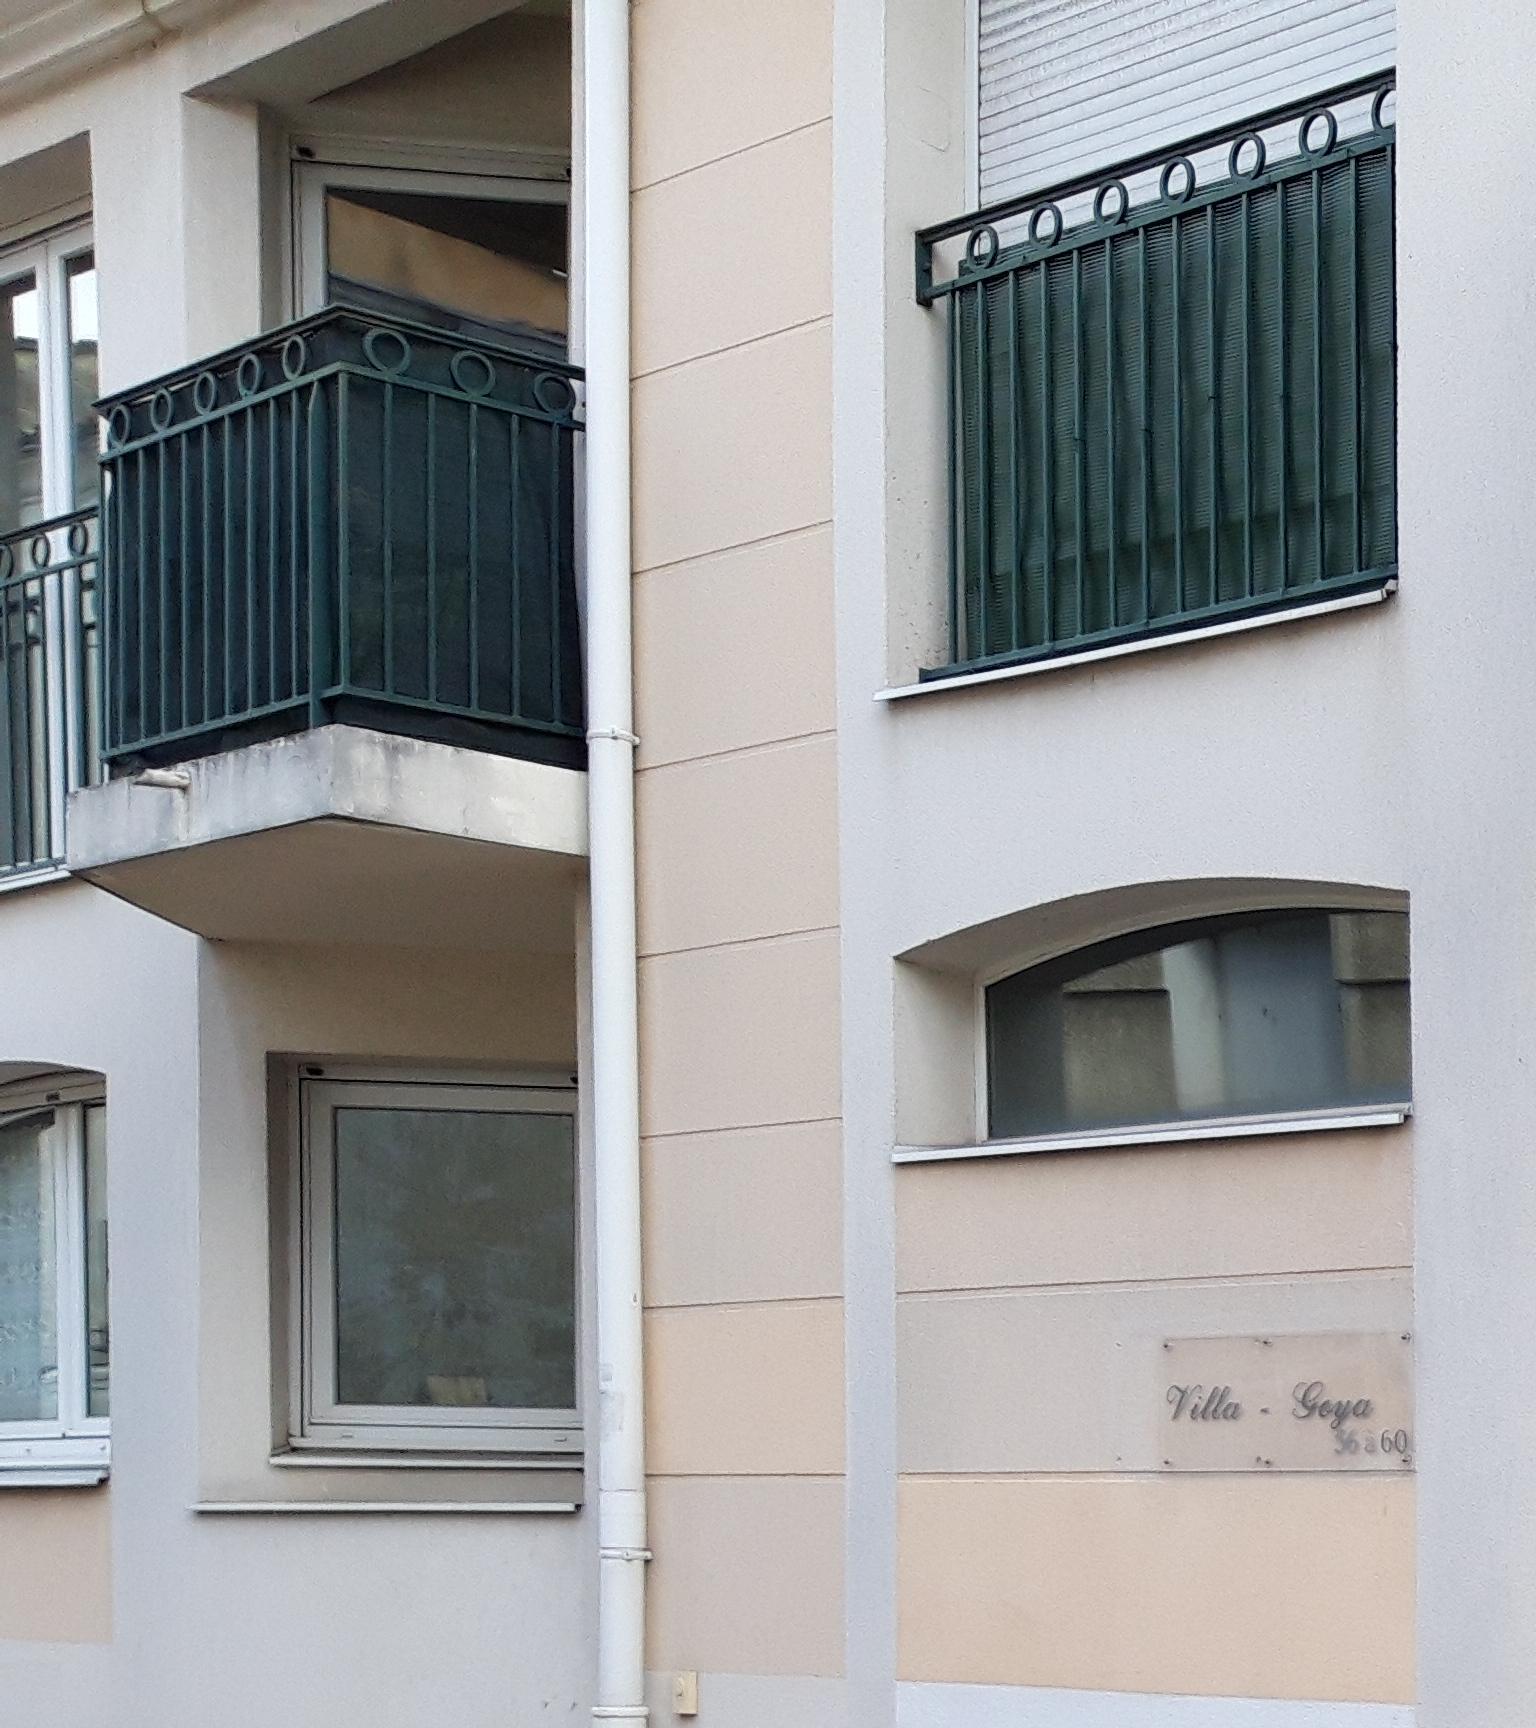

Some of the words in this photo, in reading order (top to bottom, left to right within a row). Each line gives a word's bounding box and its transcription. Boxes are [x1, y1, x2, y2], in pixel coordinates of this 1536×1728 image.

[1166, 1384, 1242, 1421] Villa
[1292, 1381, 1373, 1429] Goya
[1381, 1429, 1408, 1453] 60
